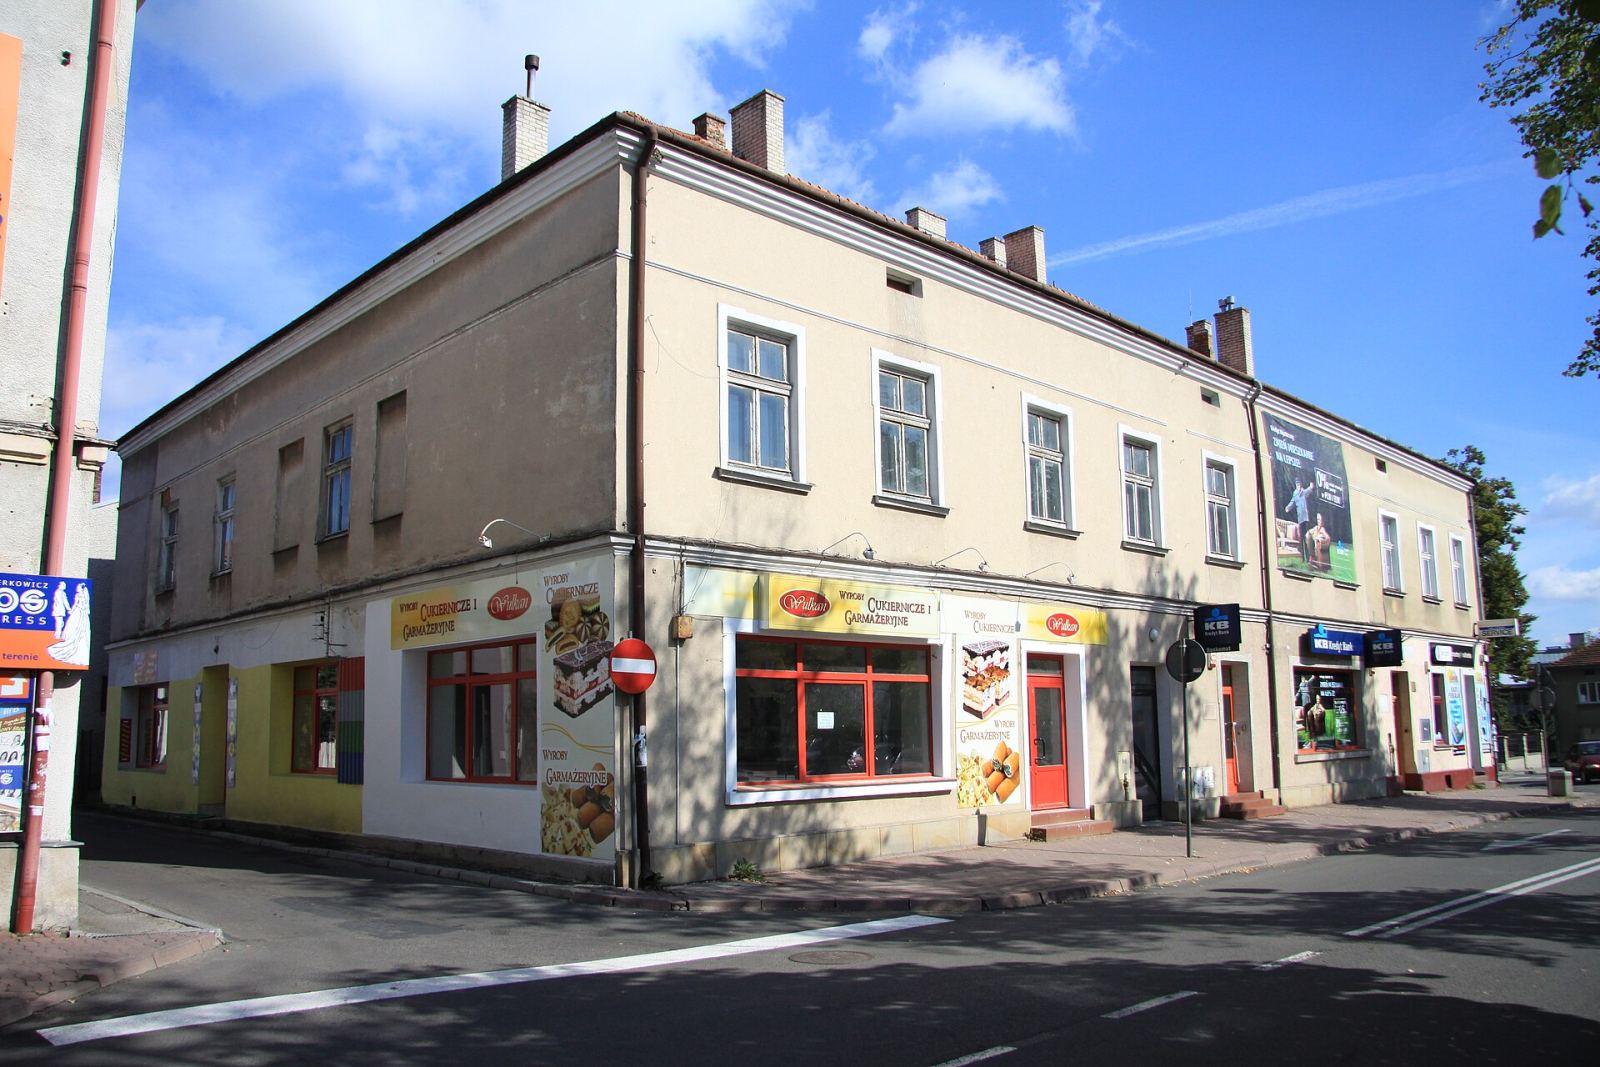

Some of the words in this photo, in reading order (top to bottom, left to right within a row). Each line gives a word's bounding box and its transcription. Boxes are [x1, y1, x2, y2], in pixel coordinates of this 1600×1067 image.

[0, 579, 48, 589] RKOWICZ
[543, 574, 569, 587] WYROBY
[839, 590, 865, 601] WYROBY
[868, 597, 926, 614] CUKIERNICZE
[399, 602, 418, 613] WYROBY
[420, 598, 471, 621] CUKIERNICZE
[964, 609, 986, 620] WYROBY
[2, 614, 47, 625] RESS
[844, 609, 909, 628] GARMAŻERYJNE
[403, 620, 455, 642] GARMAŻERYJNE
[973, 620, 1015, 634] CUKIERNICZE
[1204, 620, 1230, 631] KB
[2, 652, 39, 660] terenie
[542, 749, 568, 761] WYROBY
[546, 767, 607, 787] GARMAŻERYJNE
